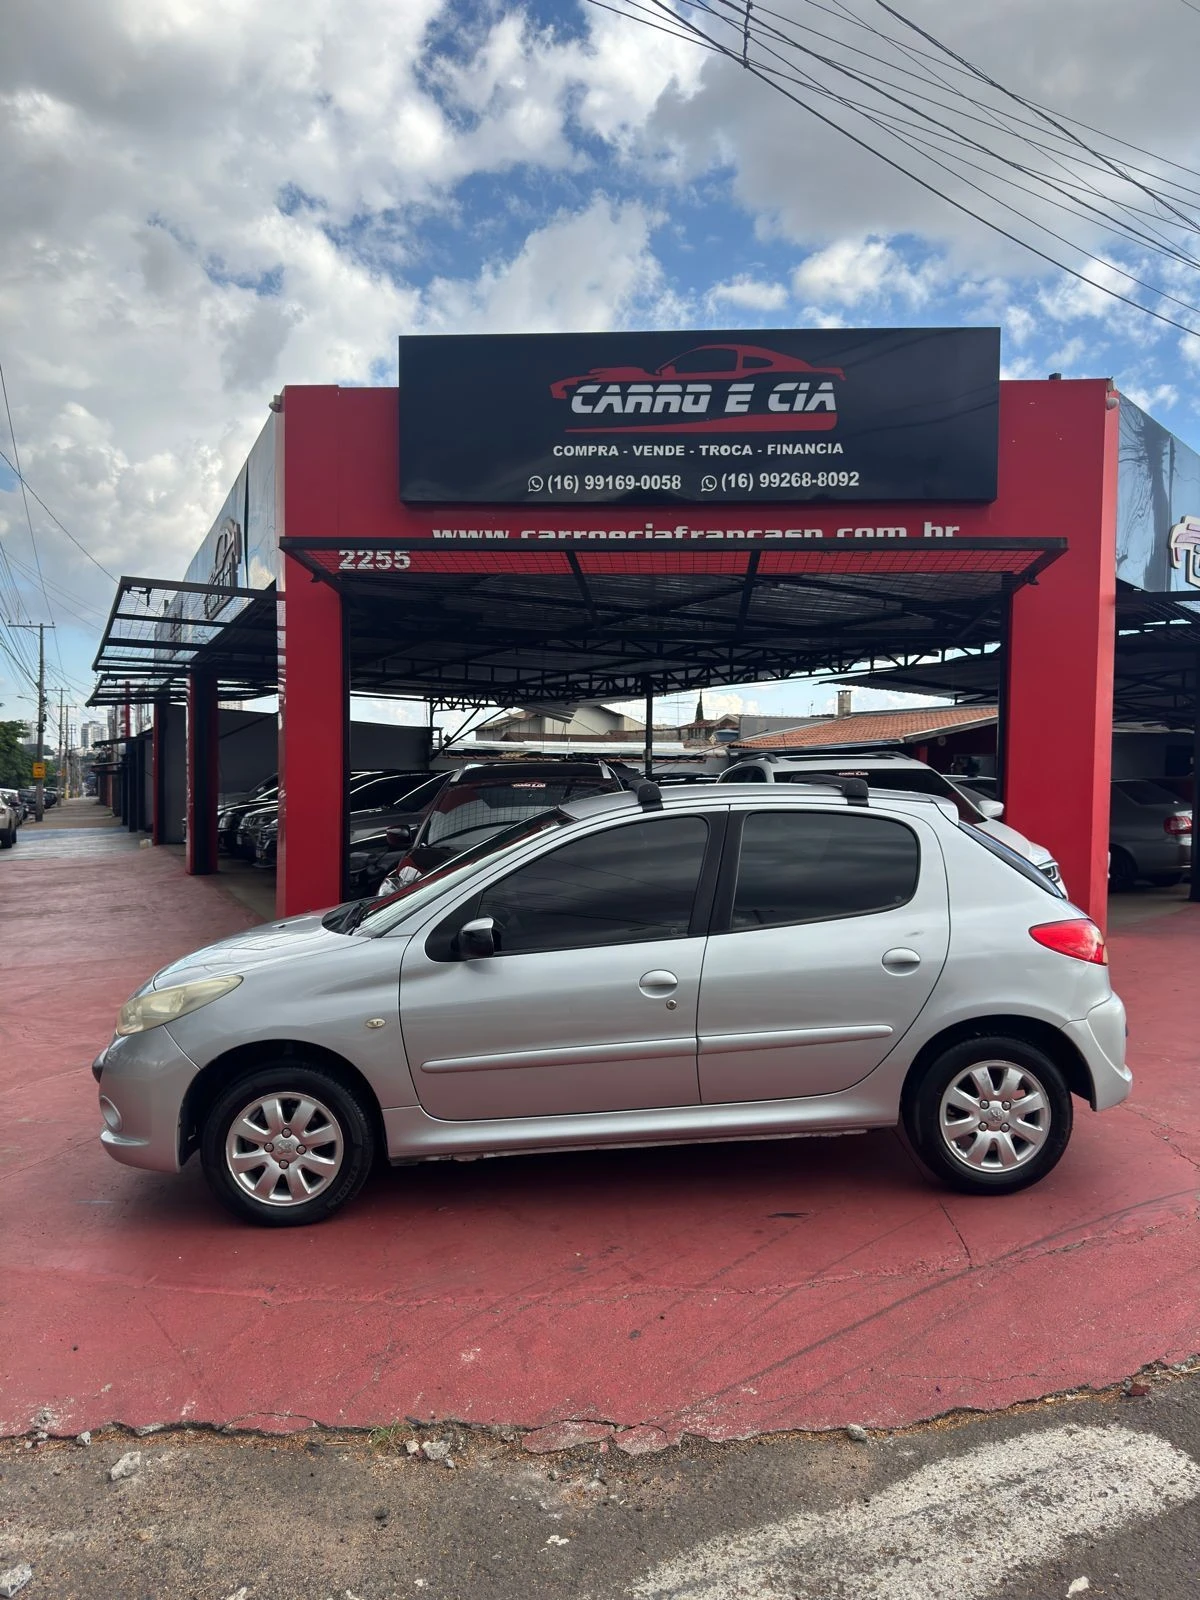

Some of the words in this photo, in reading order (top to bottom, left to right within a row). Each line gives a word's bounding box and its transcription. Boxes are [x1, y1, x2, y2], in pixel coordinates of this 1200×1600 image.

[571, 384, 712, 414] CARRO
[724, 383, 755, 413] E
[552, 445, 619, 457] COMPRA
[632, 445, 685, 457] VENDE
[699, 444, 753, 456] TROCA
[767, 443, 844, 456] FINANCIA
[547, 474, 579, 494] (16)
[584, 474, 681, 490] 99169-0058
[721, 472, 754, 492] (16)
[759, 471, 860, 488] 99268-8092
[338, 549, 411, 570] 2255
